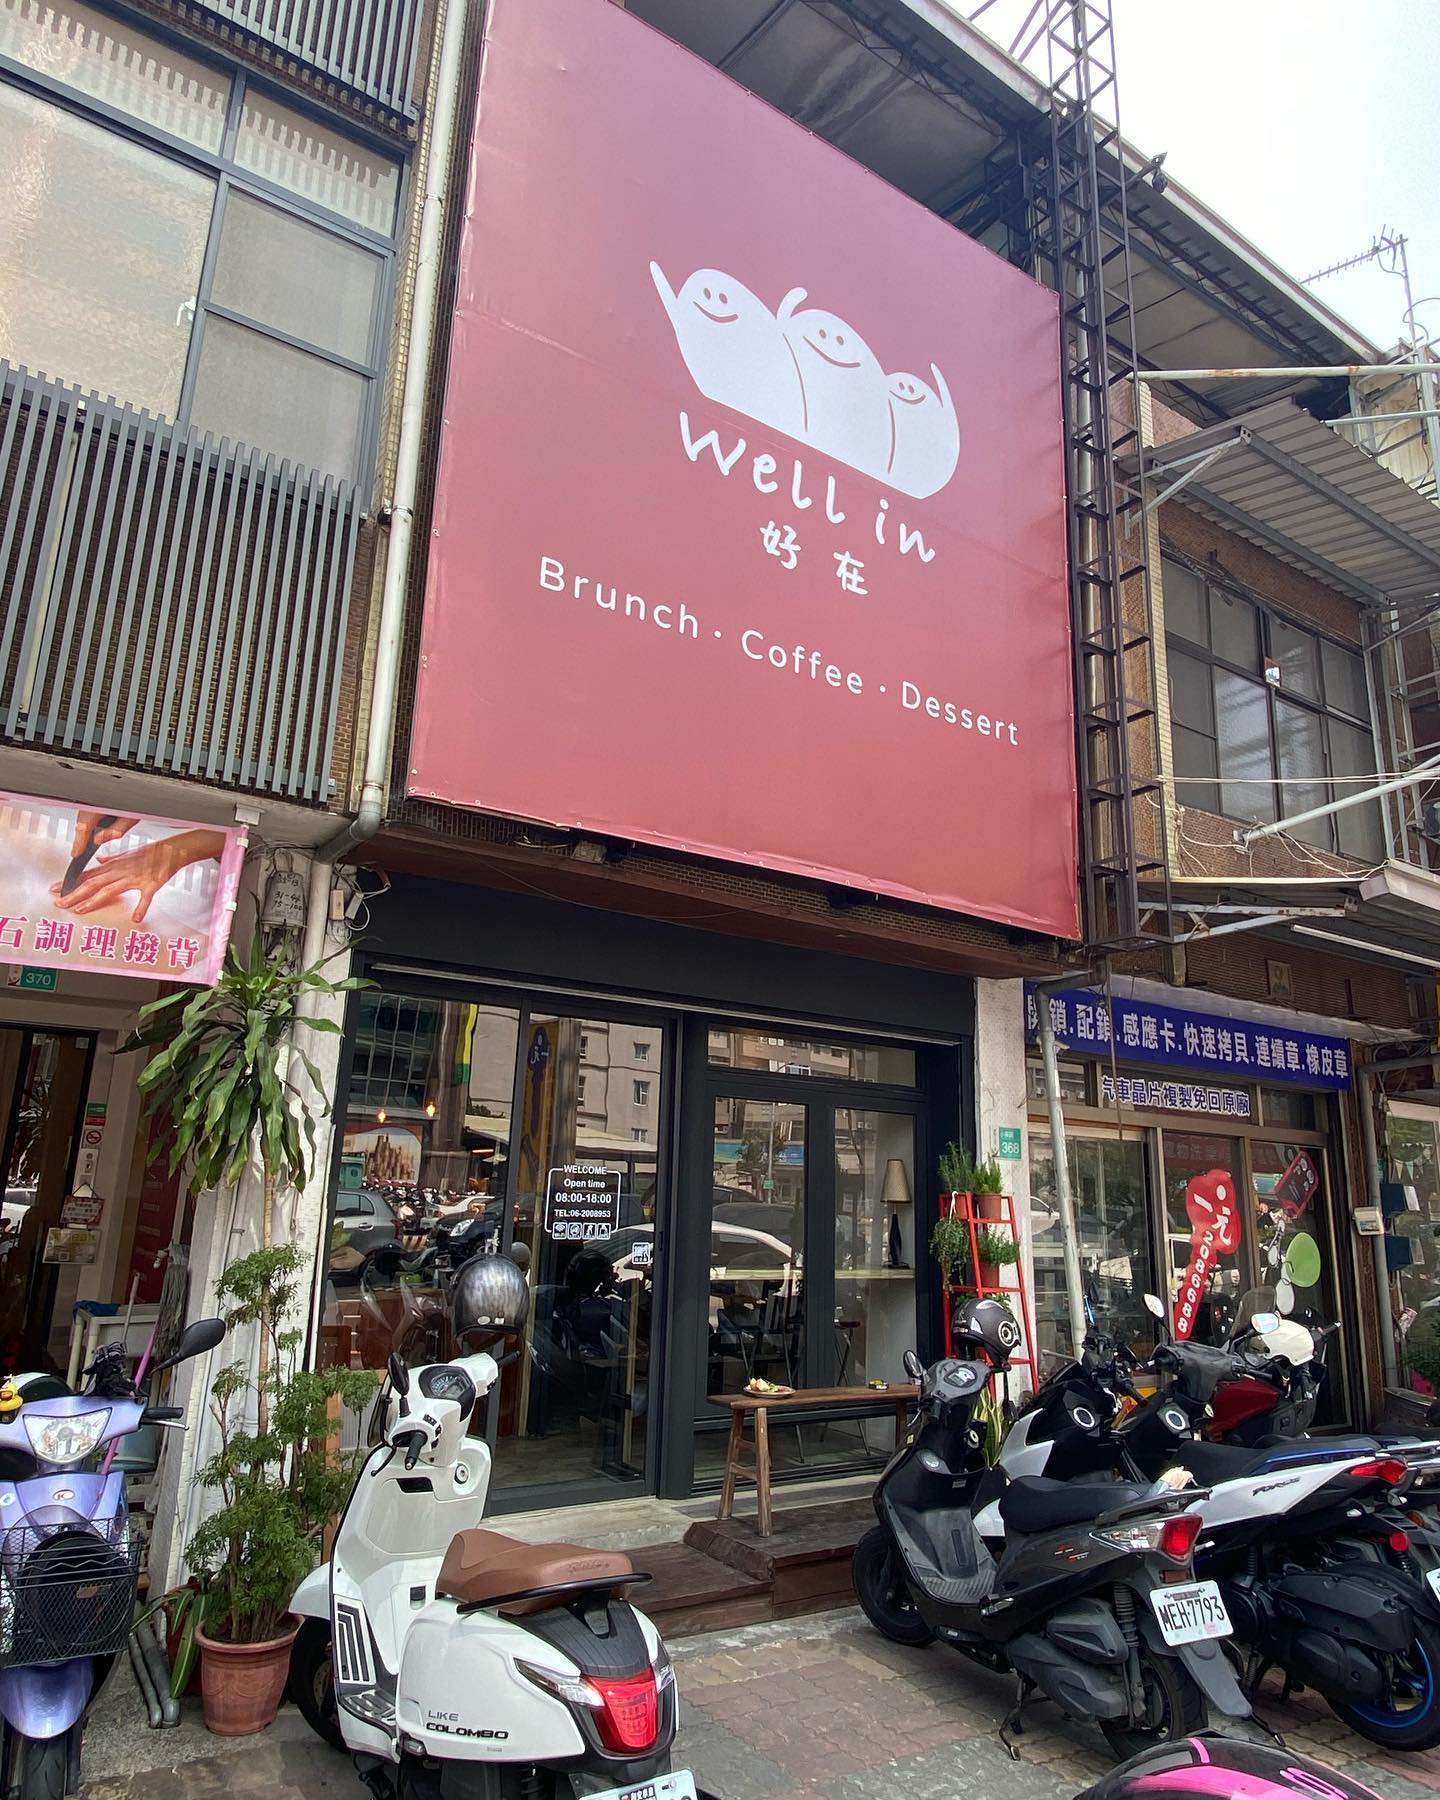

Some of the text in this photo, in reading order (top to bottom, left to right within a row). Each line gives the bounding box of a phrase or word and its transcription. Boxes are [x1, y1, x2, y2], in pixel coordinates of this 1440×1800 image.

[875, 499, 935, 562] in
[760, 520, 868, 595] 好在
[540, 556, 1018, 745] Brunch Coffee Dessert
[26, 972, 51, 986] 370
[1002, 1142, 1019, 1153] 368
[564, 1165, 607, 1175] WELCOME
[564, 1179, 605, 1188] Open time
[555, 1193, 611, 1203] 08:00-18:00
[428, 1710, 459, 1721] LIKE
[426, 1722, 509, 1739] COLOMBO
